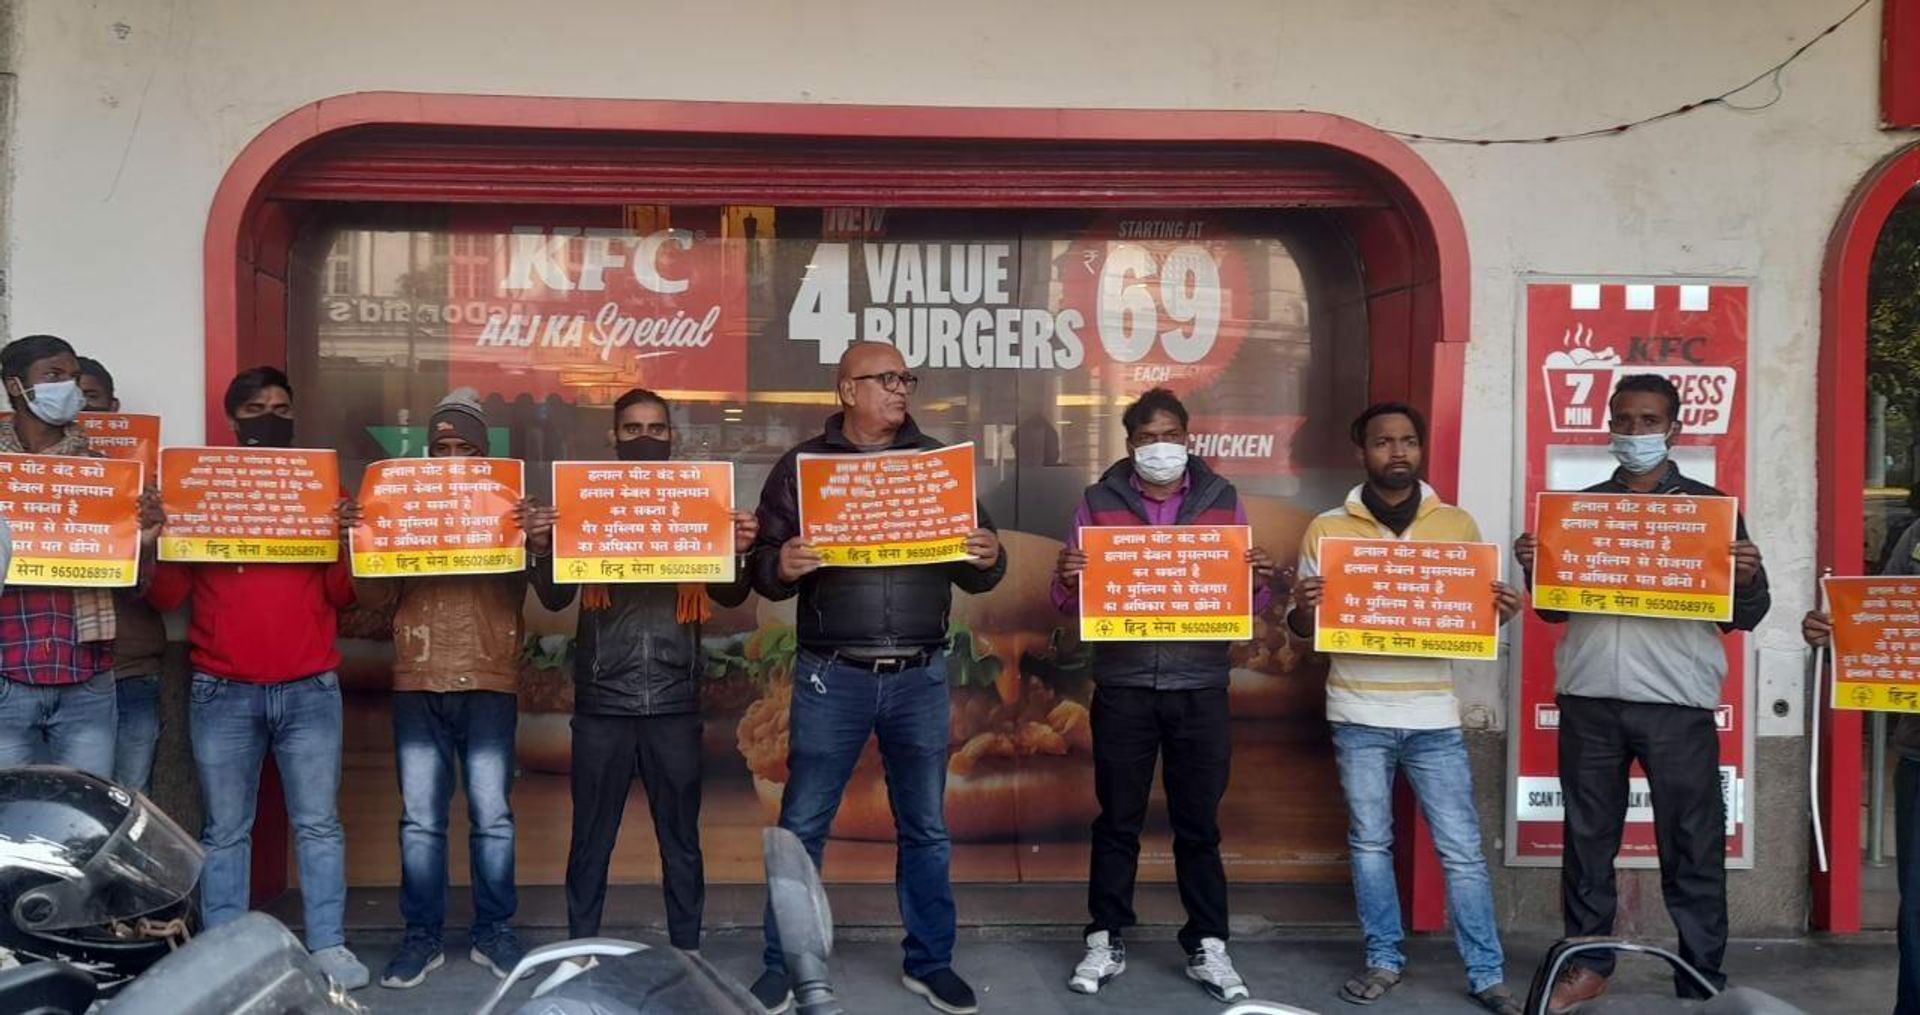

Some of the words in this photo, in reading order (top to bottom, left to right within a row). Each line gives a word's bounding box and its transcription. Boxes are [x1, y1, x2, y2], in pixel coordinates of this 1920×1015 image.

[1118, 220, 1184, 238] STARTING
[1187, 221, 1204, 238] AT
[501, 227, 693, 293] KFC
[864, 243, 1009, 304] VALUE
[788, 242, 856, 364] 4
[476, 314, 541, 347] AAJ
[540, 315, 583, 347] KA
[589, 302, 721, 360] Special
[863, 308, 1084, 370] BURGERS
[1624, 336, 1707, 365] KFC
[1134, 366, 1170, 382] EACH
[1566, 374, 1594, 404] 7
[108, 418, 129, 429] करो
[1564, 408, 1592, 425] MIN
[20, 460, 45, 473] मीट
[53, 464, 73, 477] बंद
[79, 463, 105, 477] करो
[382, 464, 416, 478] हलाल
[421, 462, 443, 475] मीट
[449, 464, 466, 475] बंद
[471, 462, 492, 475] करो
[588, 470, 623, 481] हलाल
[628, 467, 651, 480] मीट
[657, 470, 674, 480] बंद
[680, 466, 700, 480] करो
[8, 478, 44, 492] केवल
[52, 484, 114, 499] मुसलमान
[374, 484, 408, 496] हलाल
[413, 480, 442, 493] केवल
[449, 482, 500, 496] मुसलमान
[579, 488, 614, 499] हलाल
[620, 484, 650, 498] केवल
[657, 488, 709, 501] मुसलमान
[23, 502, 62, 514] सकता
[68, 500, 78, 516] है
[404, 501, 419, 510] कर
[427, 500, 458, 510] सकता
[463, 500, 472, 510] है
[610, 506, 626, 516] कर
[634, 506, 666, 515] सकता
[672, 502, 680, 517] है
[1571, 501, 1609, 513] हलाल
[1615, 500, 1640, 513] मीट
[1646, 503, 1667, 514] बंद
[1672, 500, 1697, 514] करो
[43, 519, 55, 532] से
[64, 520, 110, 534] रोजगार
[377, 516, 392, 528] गैर
[398, 519, 438, 532] मुस्लिम
[445, 516, 454, 527] से
[461, 513, 499, 525] रोजगार
[581, 520, 597, 533] गैर
[604, 523, 644, 537] मुस्लिम
[651, 521, 661, 533] से
[668, 520, 709, 533] रोजगार
[1561, 519, 1599, 530] हलाल
[1605, 516, 1638, 531] केवल
[1646, 521, 1706, 535] मुसलमान
[374, 536, 388, 546] का
[394, 534, 438, 546] अधिकार
[444, 534, 461, 545] मत
[466, 533, 492, 544] छीनो
[578, 541, 592, 551] का
[598, 539, 644, 551] अधिकार
[650, 541, 668, 551] मत
[674, 537, 701, 551] छीनो
[1112, 533, 1145, 545] हलाल
[1151, 531, 1172, 544] मीट
[1178, 533, 1195, 543] बंद
[1200, 530, 1221, 543] करो
[1592, 537, 1611, 547] कर
[1618, 538, 1655, 549] सकता
[1661, 537, 1671, 551] है
[41, 541, 62, 552] मत
[69, 540, 100, 553] छीनो
[206, 541, 231, 558] हिन्दू
[238, 540, 261, 556] सेना
[848, 549, 871, 564] हिन्दू
[878, 546, 900, 559] सेना
[1353, 546, 1387, 557] हलाल
[1393, 546, 1416, 558] मीट
[1422, 548, 1440, 559] बंद
[1446, 546, 1467, 560] करो
[396, 556, 421, 571] हिन्दू
[426, 552, 448, 566] सेना
[1104, 551, 1138, 562] हलाल
[1143, 548, 1171, 560] केवल
[1178, 551, 1228, 564] मुसलमान
[1562, 550, 1578, 564] गैर
[1586, 552, 1630, 569] मुस्लिम
[1638, 553, 1649, 566] से
[1656, 556, 1703, 570] रोजगार
[16, 561, 44, 576] सेना
[600, 560, 624, 576] हिन्दू
[631, 558, 654, 574] सेना
[1132, 568, 1148, 577] कर
[1155, 568, 1187, 577] सकता
[1192, 563, 1200, 578] है
[1344, 564, 1378, 574] हलाल
[1384, 561, 1414, 575] केवल
[1421, 566, 1476, 580] मुसलमान
[1557, 571, 1573, 581] का
[1579, 569, 1628, 583] अधिकार
[1636, 575, 1656, 585] मत
[1662, 574, 1692, 587] छीनो
[1106, 581, 1121, 594] गैर
[1128, 584, 1166, 597] मुस्लिम
[1173, 581, 1182, 593] से
[1189, 582, 1227, 593] रोजगार
[1373, 581, 1390, 590] कर
[1397, 582, 1429, 592] सकता
[1435, 581, 1445, 594] है
[1104, 602, 1117, 611] का
[1123, 600, 1165, 611] अधिकार
[1171, 602, 1188, 610] मत
[1194, 599, 1221, 611] छीनो
[1344, 594, 1359, 607] गैर
[1366, 596, 1407, 611] मुस्लिम
[1414, 598, 1424, 609] से
[1432, 599, 1473, 612] रोजगार
[1579, 592, 1606, 609] हिन्दू
[1613, 591, 1639, 607] सेना
[1124, 619, 1148, 636] हिन्दू
[1154, 618, 1176, 632] सेना
[1340, 613, 1355, 624] का
[1359, 614, 1405, 626] अधिकार
[1412, 618, 1431, 627] मत
[1437, 616, 1464, 628] छीनो
[1361, 633, 1386, 650] हिन्दू
[1392, 633, 1415, 648] सेना
[1529, 791, 1552, 807] SCAN
